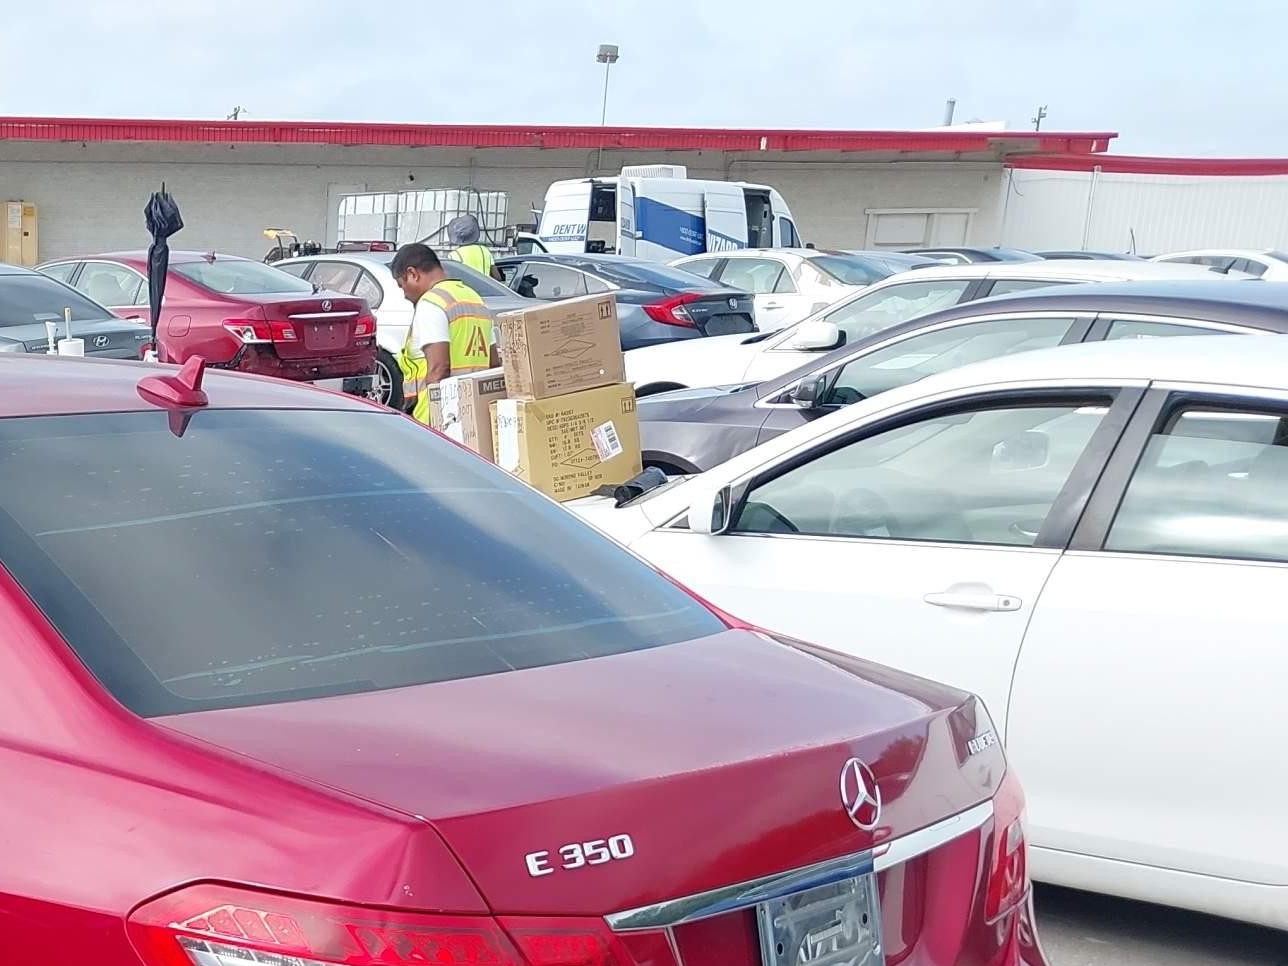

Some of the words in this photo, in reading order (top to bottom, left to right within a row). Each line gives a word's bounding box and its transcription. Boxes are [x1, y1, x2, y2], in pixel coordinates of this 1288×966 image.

[553, 224, 577, 235] DENT
[525, 850, 555, 877] E
[558, 833, 635, 869] 350
